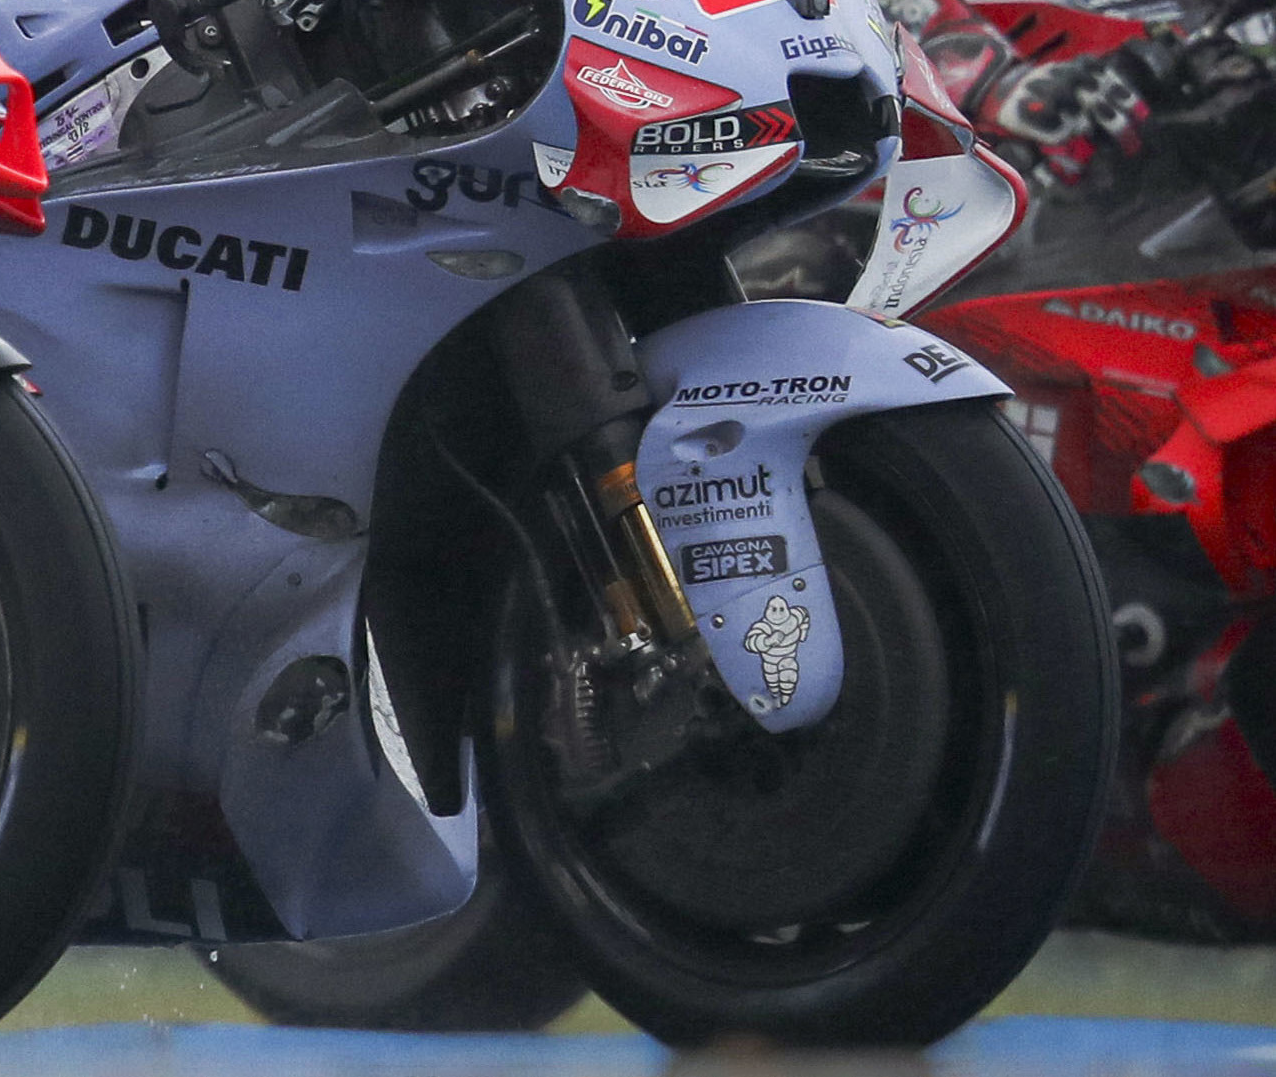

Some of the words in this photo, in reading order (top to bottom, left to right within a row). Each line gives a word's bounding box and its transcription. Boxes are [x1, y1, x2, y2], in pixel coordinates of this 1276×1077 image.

[584, 70, 641, 94] FEDERAL
[643, 91, 666, 104] OIL
[636, 116, 741, 146] BOLD
[634, 139, 744, 152] RIDERS
[61, 203, 309, 292] DUCATI
[1078, 302, 1196, 340] DAIKO
[675, 375, 852, 403] MOTO-TRON
[758, 394, 848, 406] RACING
[655, 464, 771, 510] azimut
[656, 502, 771, 528] investimenti
[692, 539, 773, 558] CAVAGNA
[692, 555, 775, 581] SIPEX
